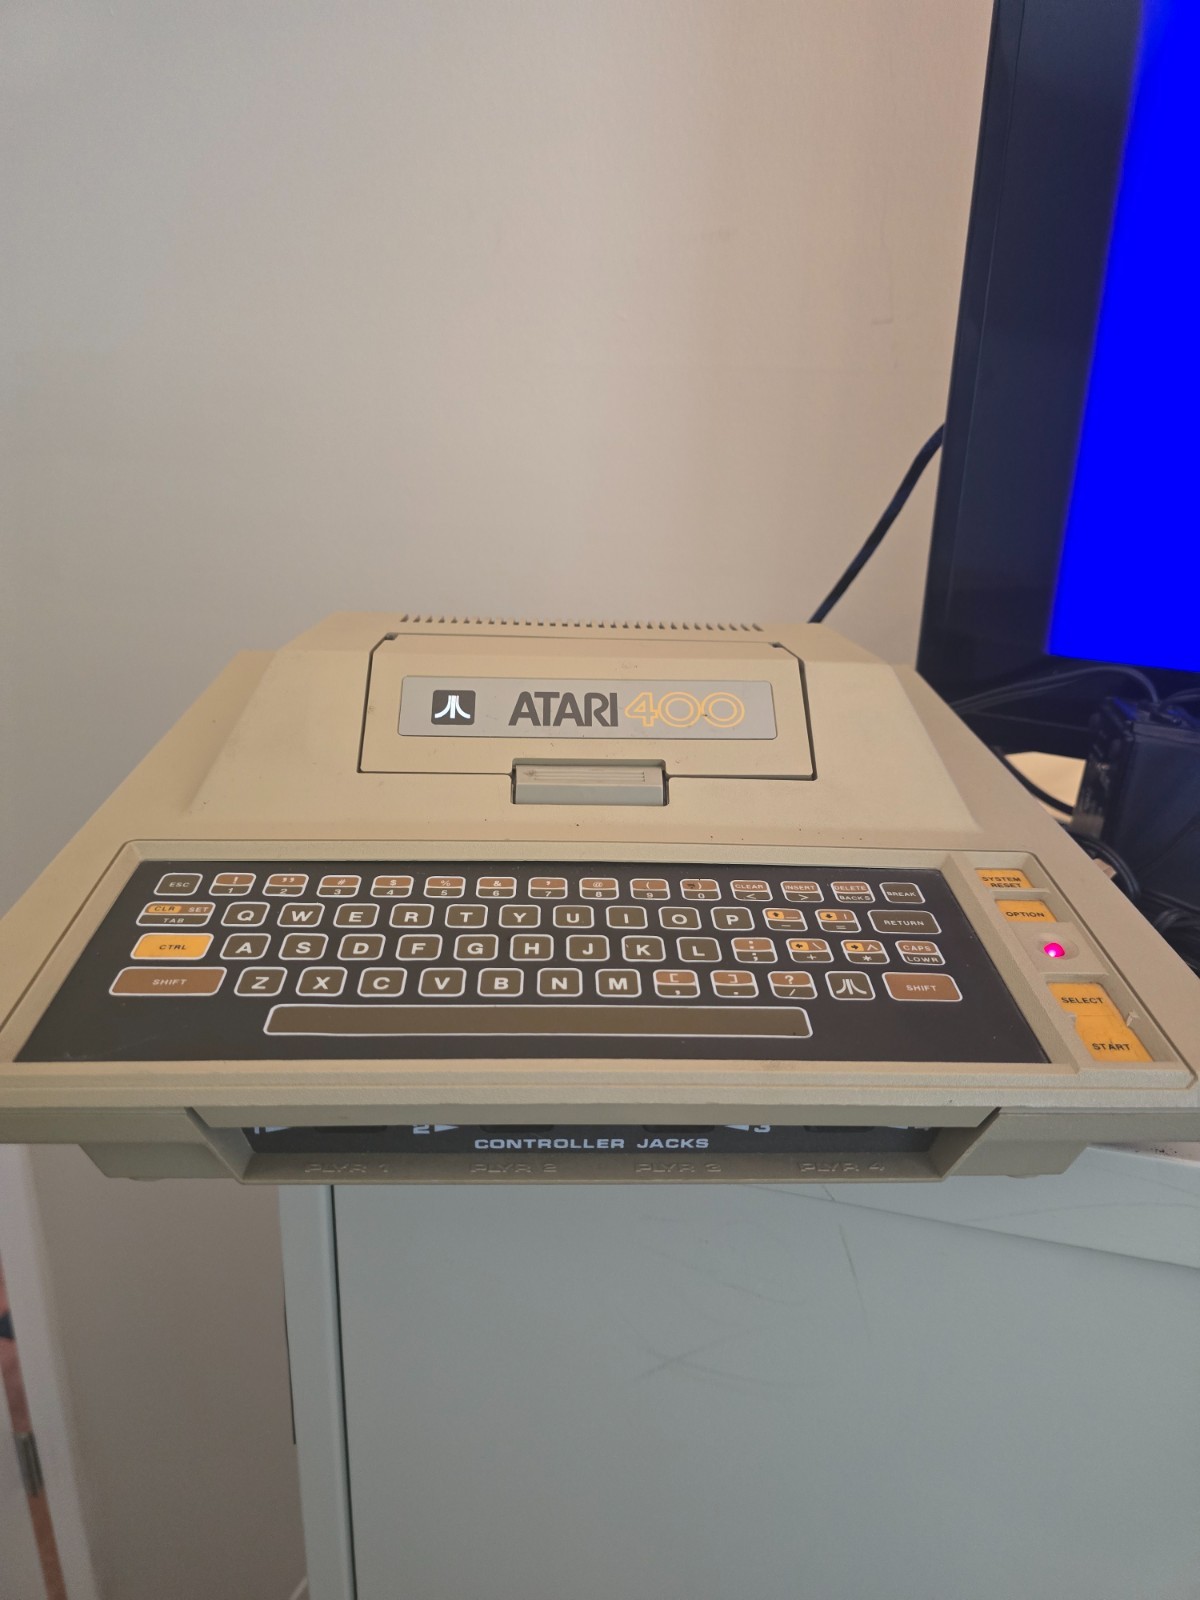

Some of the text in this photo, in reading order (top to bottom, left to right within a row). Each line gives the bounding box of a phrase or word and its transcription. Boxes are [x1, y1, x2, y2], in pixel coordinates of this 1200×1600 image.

[508, 691, 745, 728] ATARI 400
[237, 910, 254, 921] Q
[292, 911, 313, 922] W
[349, 912, 363, 922] E
[404, 912, 418, 922] R
[460, 912, 473, 922] T
[513, 912, 527, 922] Y
[567, 913, 580, 923] U
[623, 913, 629, 923] I
[672, 914, 688, 924] O
[726, 914, 739, 925] P
[235, 942, 252, 953] A
[296, 942, 311, 954] S
[353, 942, 369, 954] D
[412, 942, 426, 954] F
[467, 943, 483, 954] G
[525, 942, 540, 954] H
[582, 943, 593, 955] J
[637, 944, 651, 956] K
[692, 945, 705, 956] L
[251, 977, 269, 989] Z
[312, 977, 330, 989] X
[373, 977, 391, 990] C
[434, 977, 450, 990] V
[494, 977, 509, 990] B
[552, 978, 568, 990] N
[608, 978, 628, 990] M
[785, 975, 794, 984] ?
[474, 1138, 709, 1149] CONTROLLER JACKS
[305, 1163, 366, 1173] PLYR
[470, 1163, 558, 1173] PLYR 2
[636, 1163, 696, 1173] PLYR
[801, 1162, 885, 1172] PLYR 4
